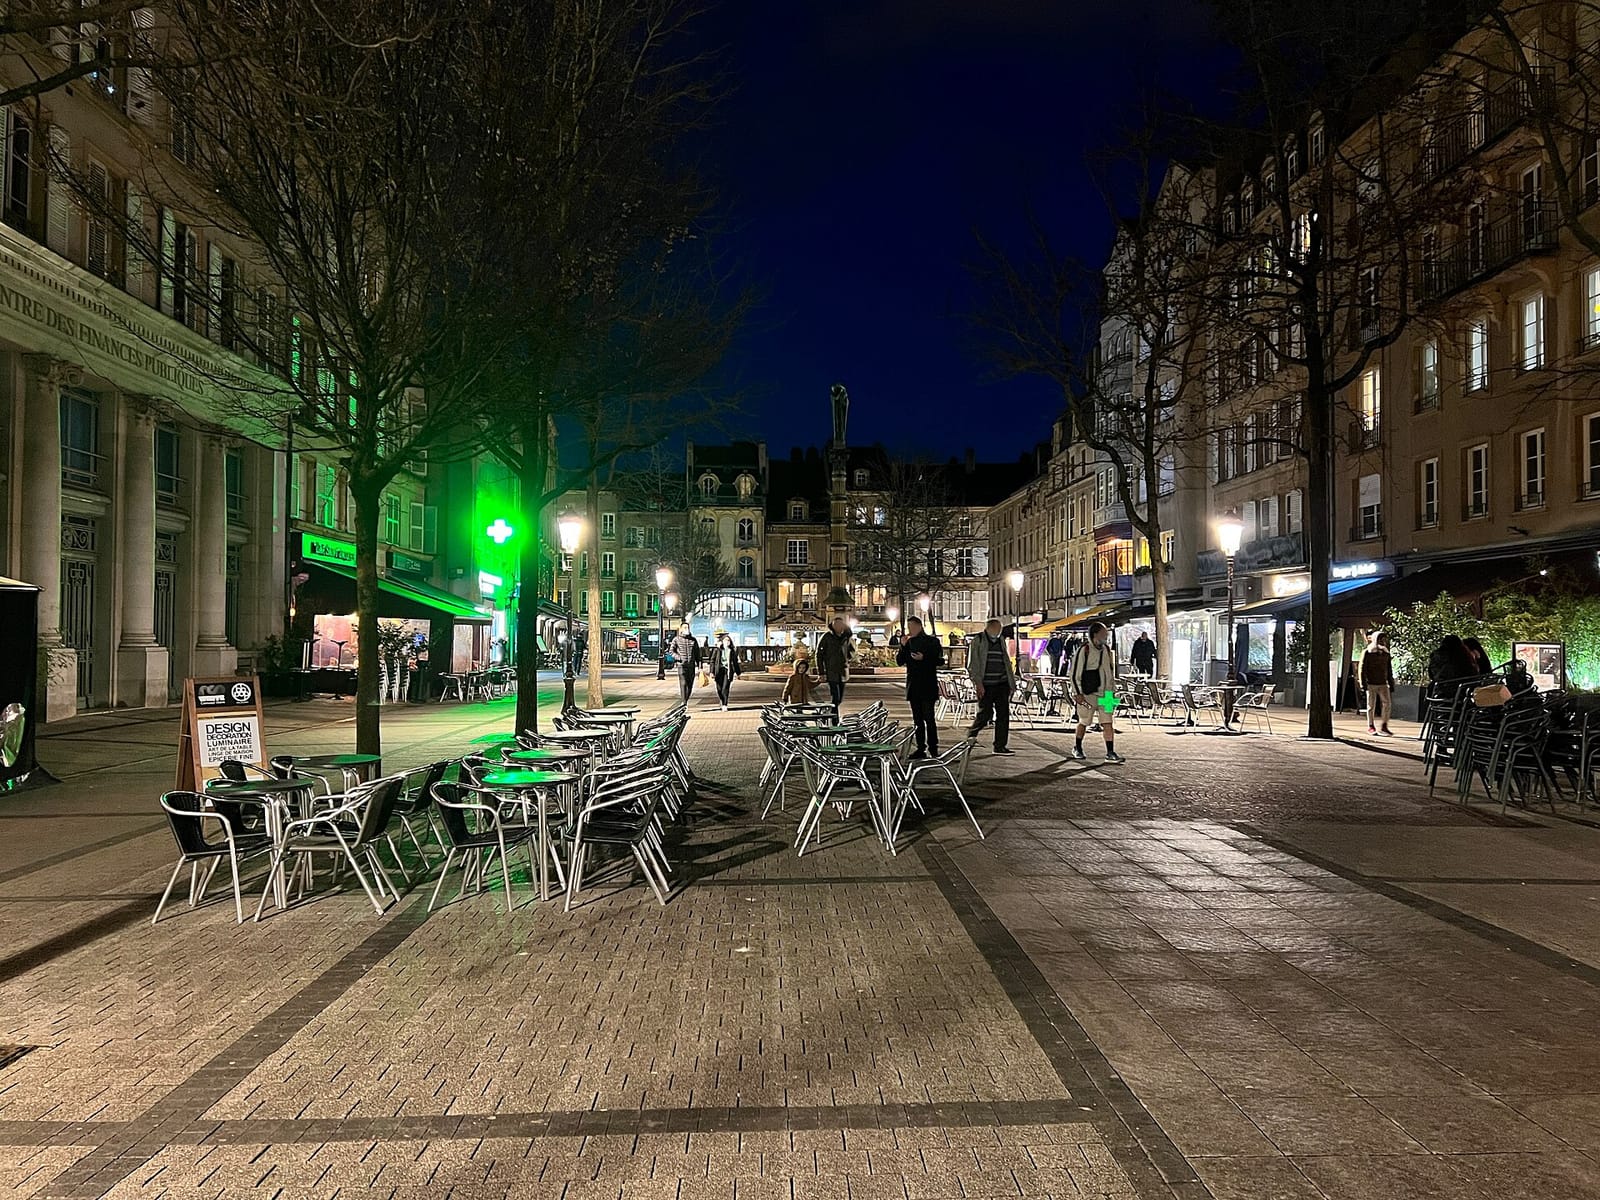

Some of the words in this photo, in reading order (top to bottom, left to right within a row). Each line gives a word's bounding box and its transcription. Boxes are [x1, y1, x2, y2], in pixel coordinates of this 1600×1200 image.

[47, 306, 74, 337] DES
[80, 323, 142, 367] FINANCES
[145, 354, 203, 395] PUBLIQUES
[206, 722, 251, 734] DESIGN
[207, 732, 252, 740] DECORATION
[207, 738, 252, 747] LUMINAIRE
[208, 755, 238, 763] EPICERIE
